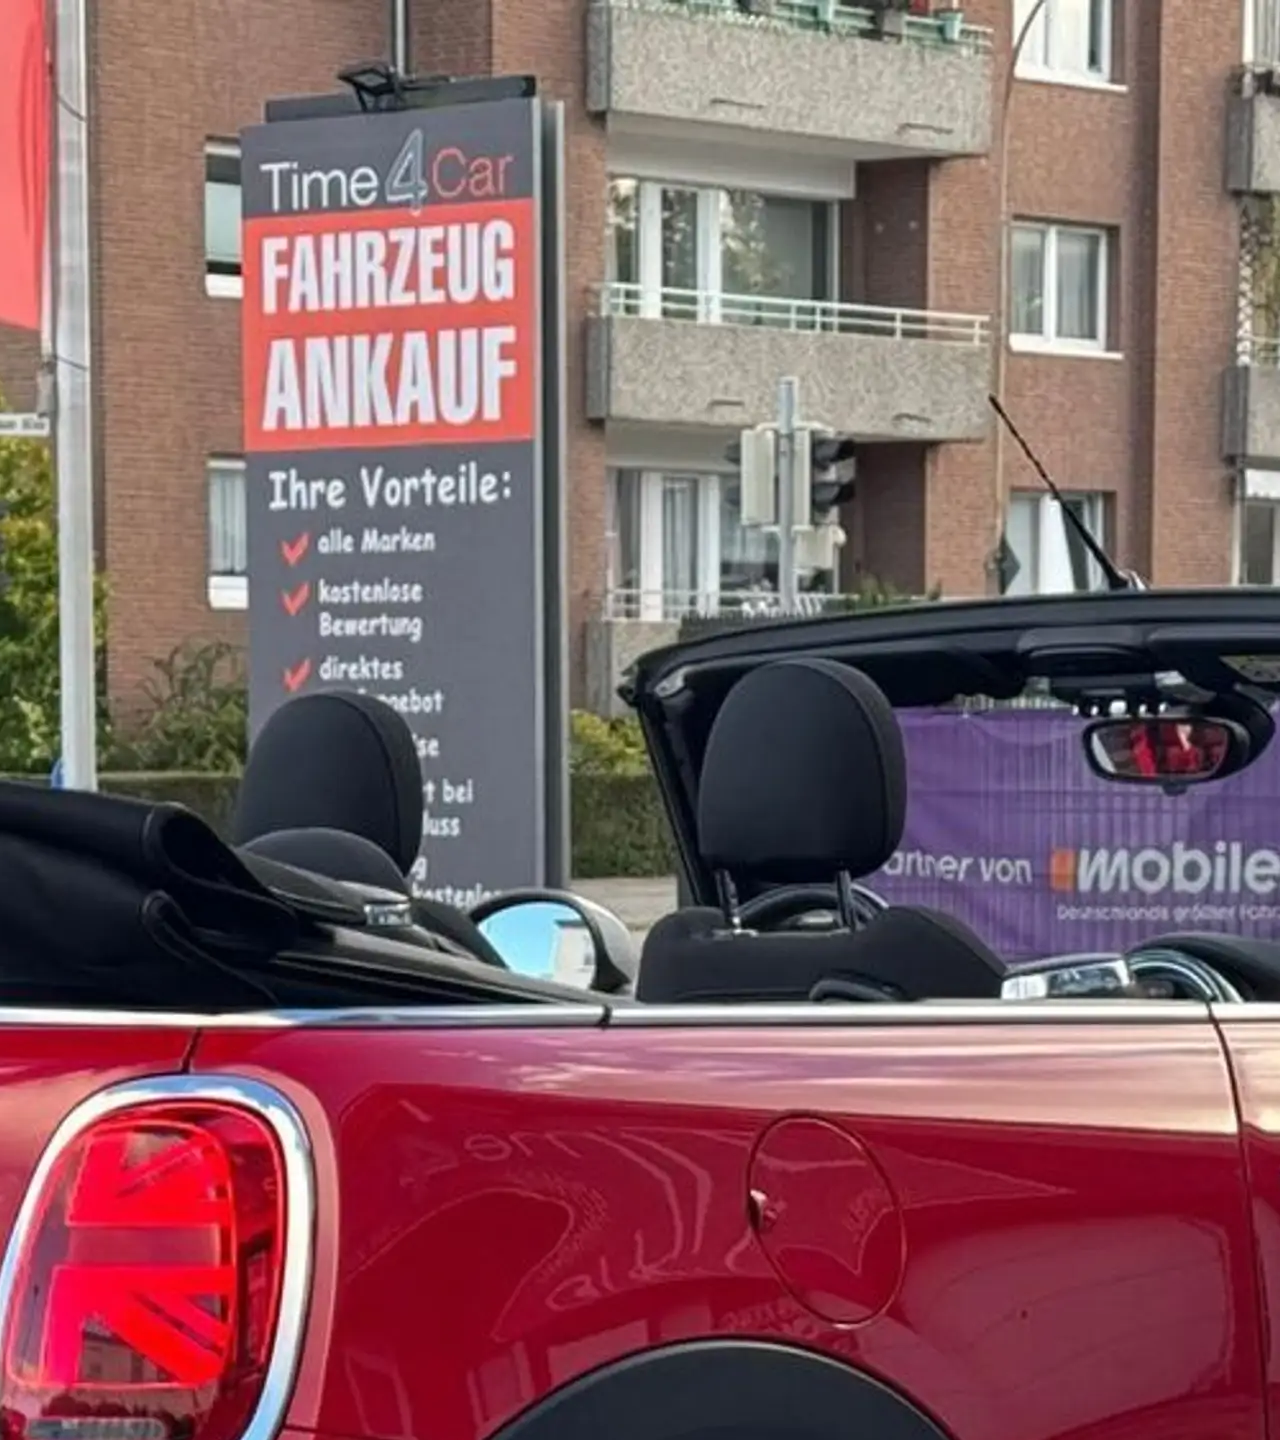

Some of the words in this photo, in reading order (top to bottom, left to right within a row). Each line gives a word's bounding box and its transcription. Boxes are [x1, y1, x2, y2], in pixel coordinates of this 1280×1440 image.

[261, 219, 515, 315] FAHRZEUG
[261, 326, 518, 432] ANKAUF
[268, 468, 347, 511] Ihre
[361, 462, 512, 508] Vorteile:
[317, 526, 355, 555] alle
[361, 525, 437, 555] Marken
[318, 577, 424, 604] kostenlose
[319, 611, 424, 643] Bewertung
[319, 655, 404, 681] direktes
[441, 778, 473, 804] bei
[882, 849, 975, 882] artner
[978, 855, 1034, 885] von
